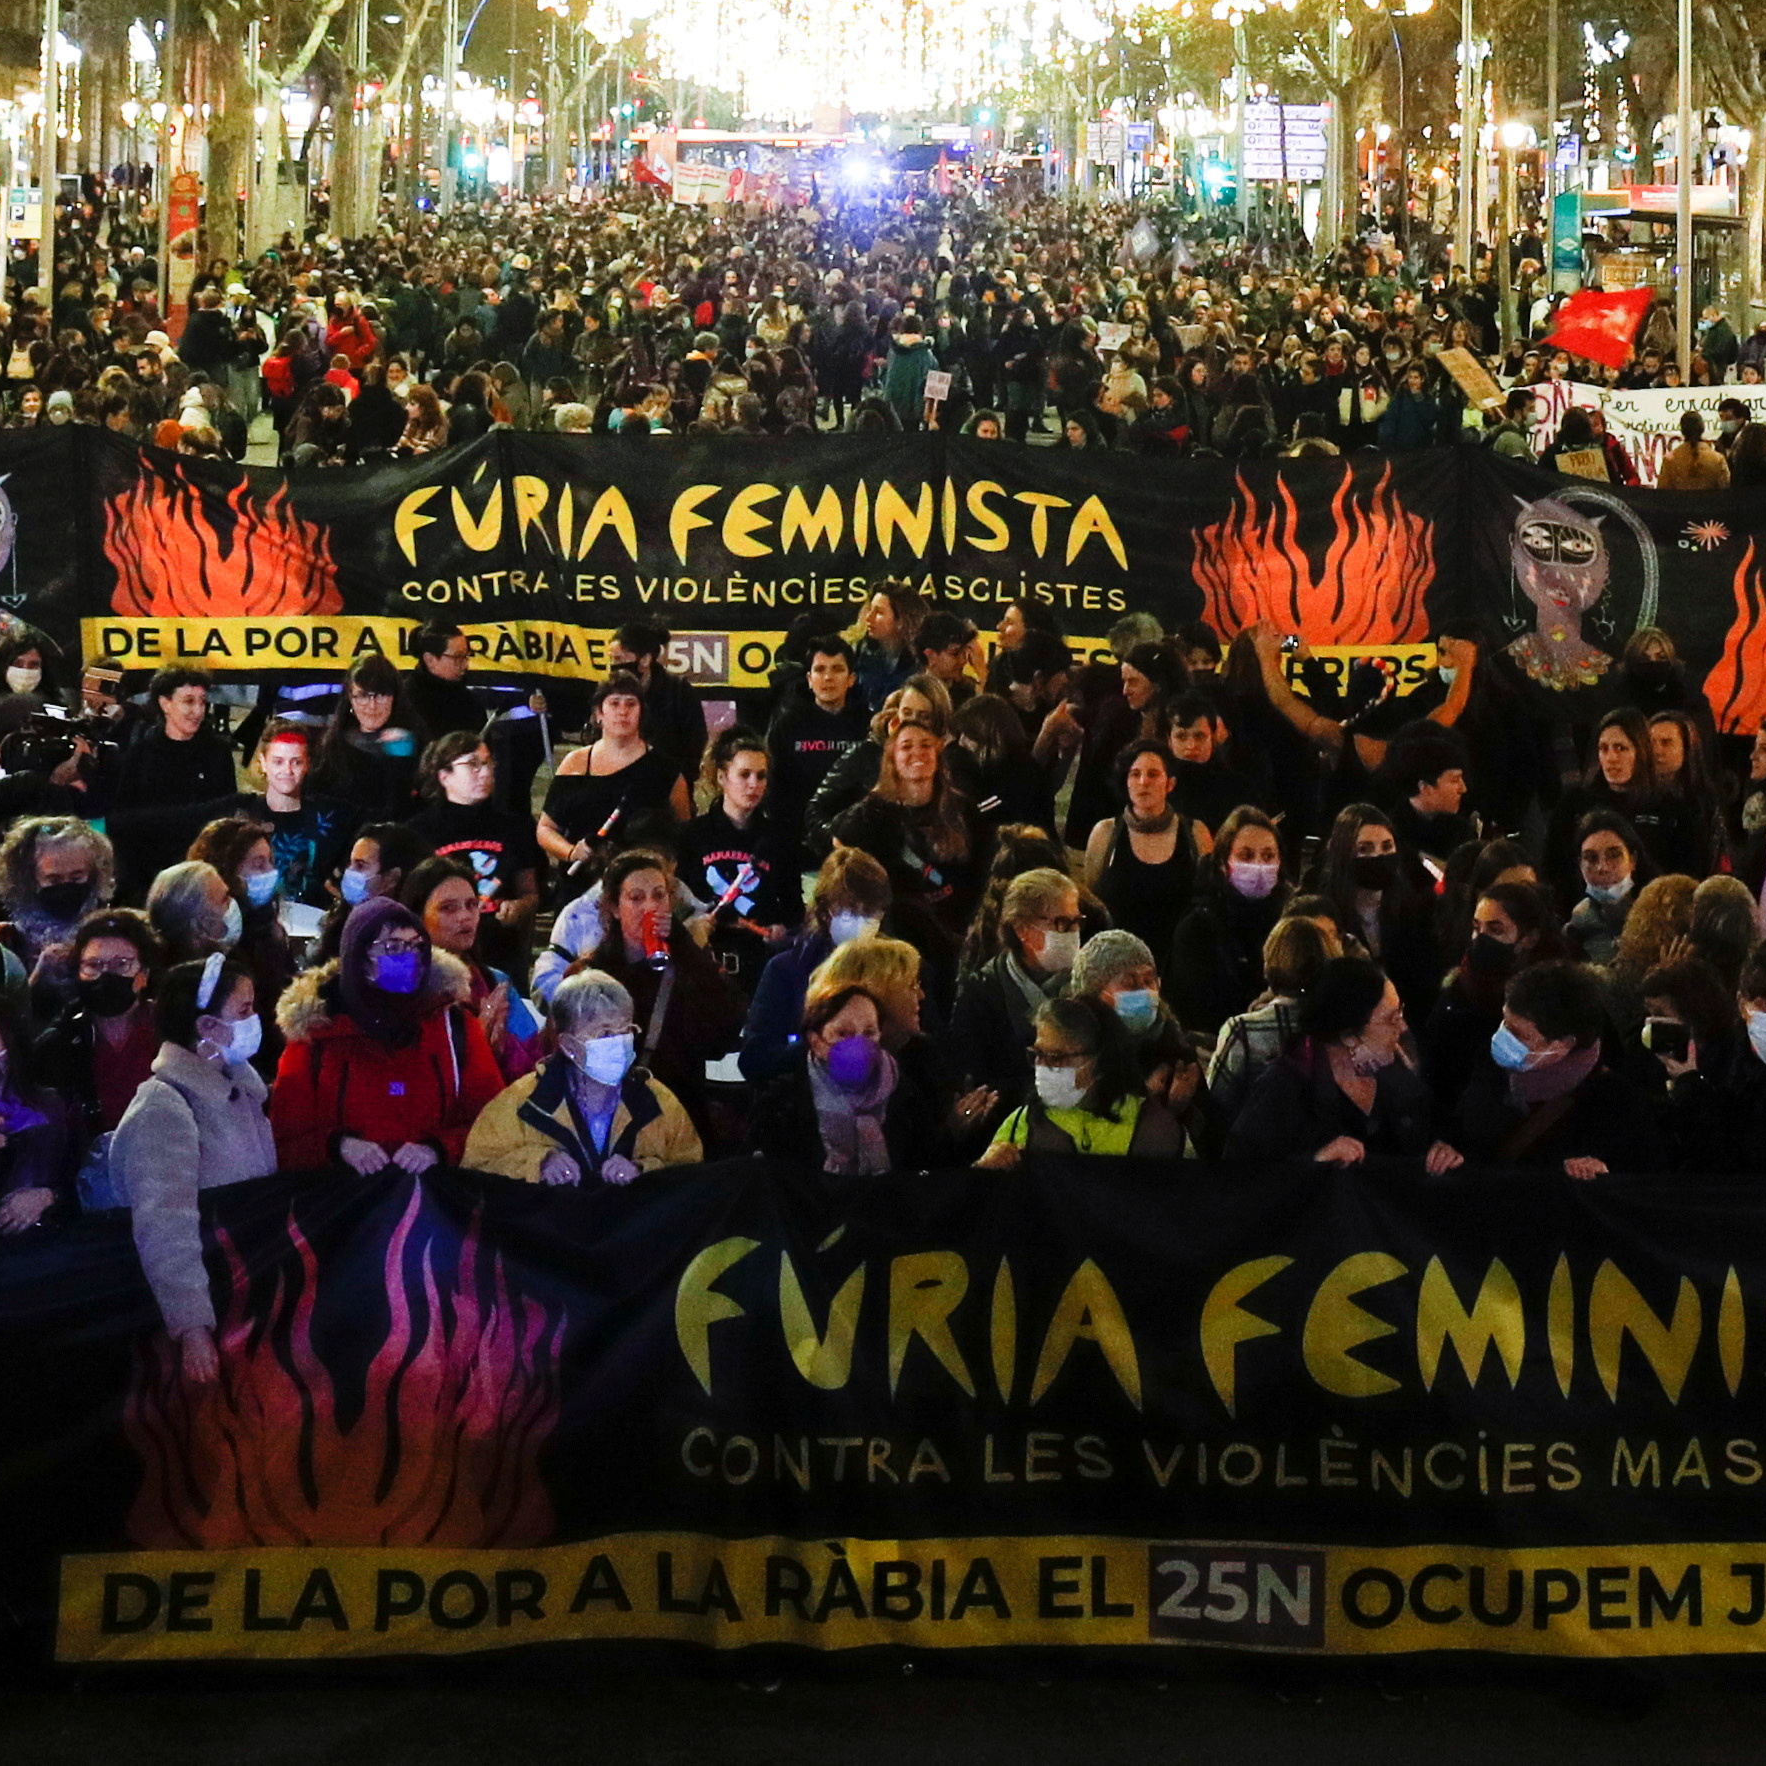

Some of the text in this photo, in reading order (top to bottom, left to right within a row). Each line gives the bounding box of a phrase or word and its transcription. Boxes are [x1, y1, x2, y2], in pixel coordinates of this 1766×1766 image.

[395, 460, 1129, 571] FÚRIA FEMINISTA
[102, 628, 165, 658] DE
[175, 627, 236, 658] LA
[246, 627, 338, 658] POR
[352, 625, 391, 657] A
[467, 624, 581, 665] RÀBIA
[674, 1224, 1142, 1410] FÚRIA
[681, 1426, 950, 1492] CONTRA
[982, 1431, 1114, 1487] LES
[101, 1571, 215, 1634] DE
[242, 1566, 349, 1633] LA
[373, 1566, 547, 1635] POR
[568, 1552, 633, 1615] A
[656, 1550, 744, 1625] LA
[763, 1541, 1013, 1623] RÀBIA
[1037, 1553, 1135, 1620] EL
[1155, 1559, 1317, 1627] 25N
[1341, 1560, 1706, 1631] OCUPEM
